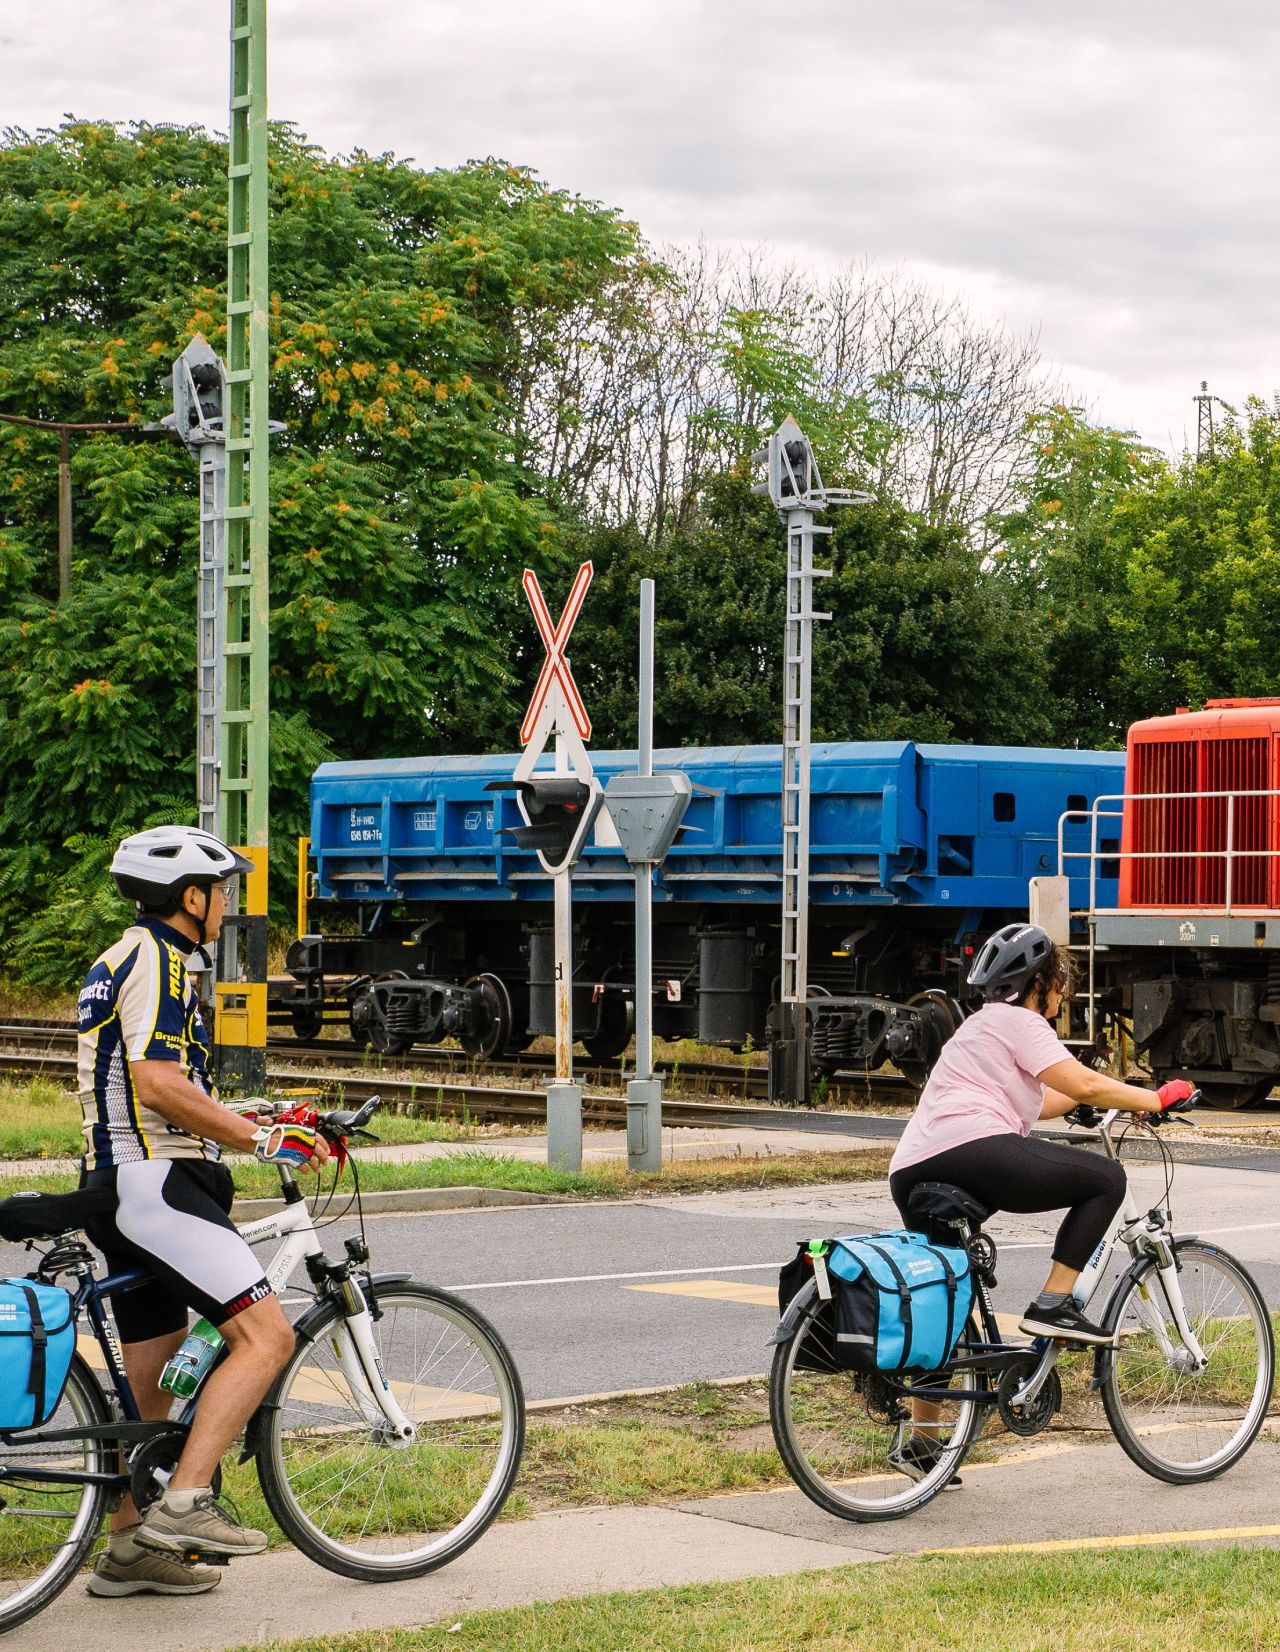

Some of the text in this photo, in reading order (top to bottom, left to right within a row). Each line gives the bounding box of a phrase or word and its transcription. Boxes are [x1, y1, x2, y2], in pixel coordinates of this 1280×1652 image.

[1179, 932, 1196, 942] 200m
[250, 1283, 270, 1303] rh+
[101, 1319, 128, 1378] SCHAUFF
